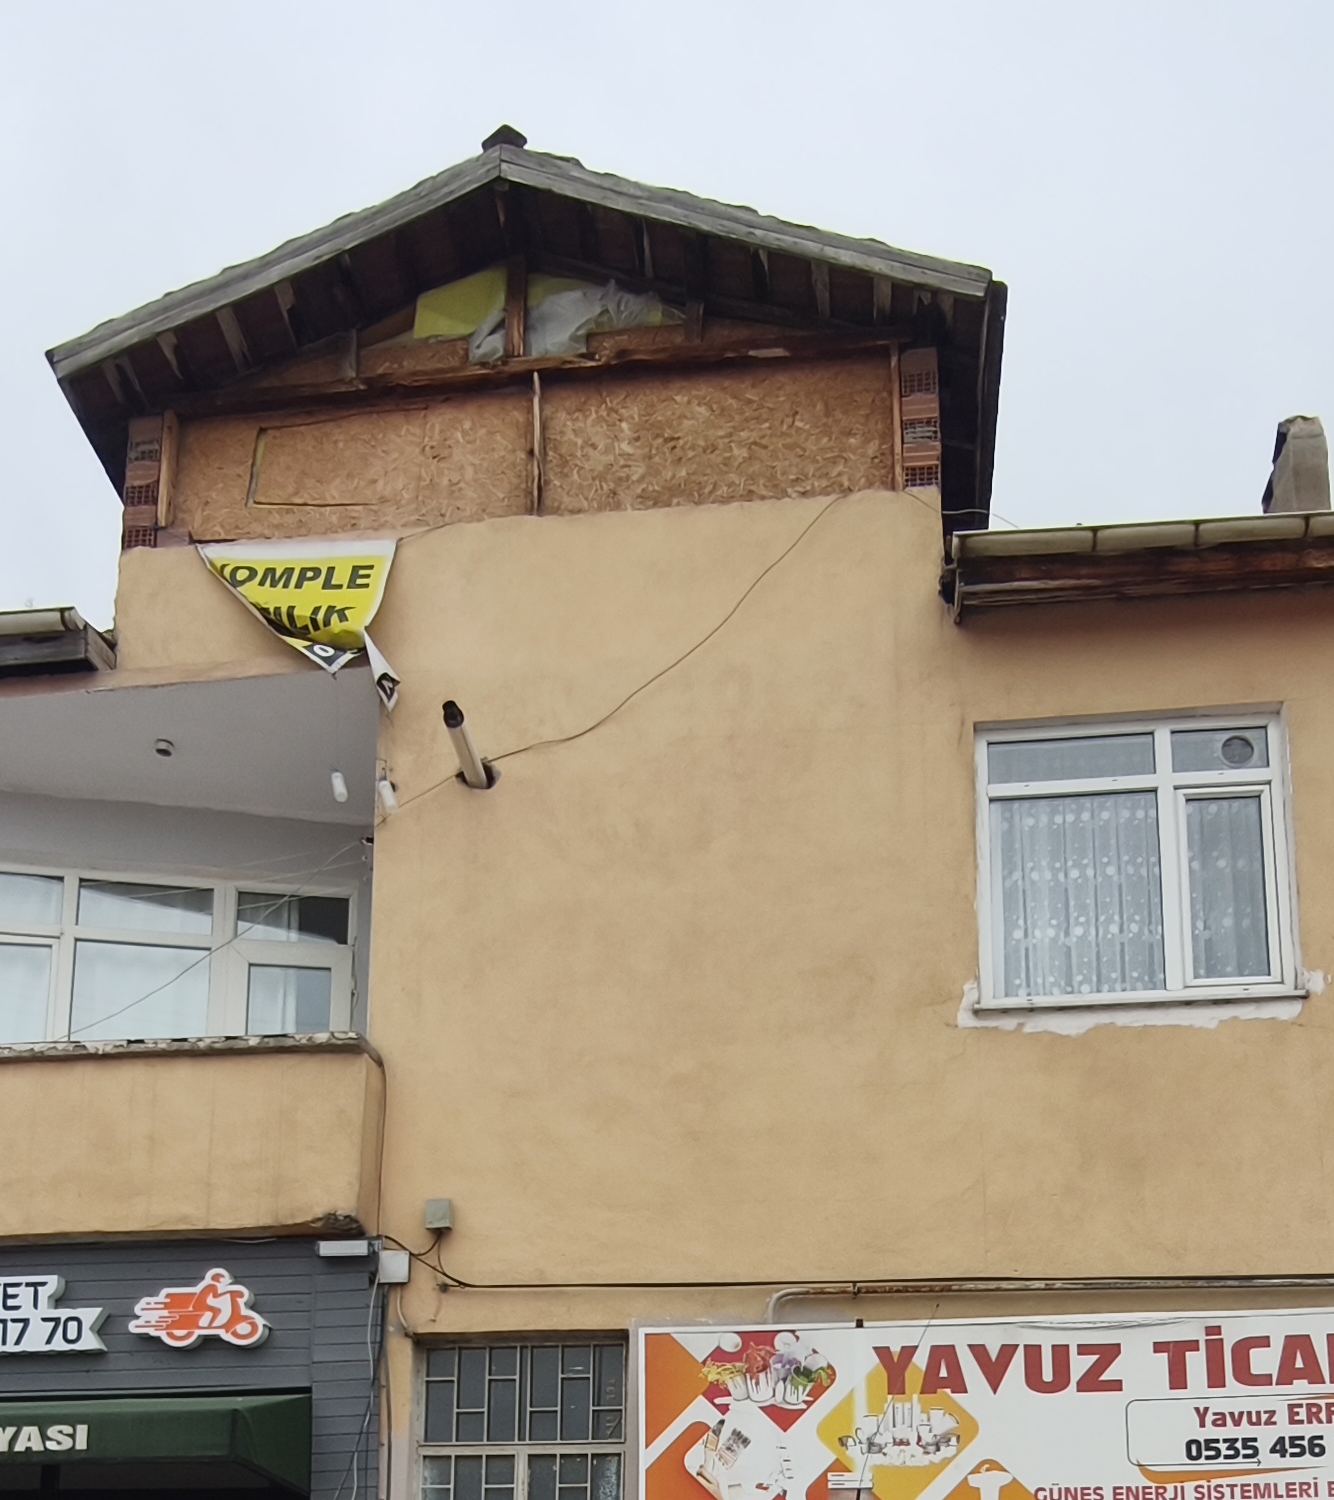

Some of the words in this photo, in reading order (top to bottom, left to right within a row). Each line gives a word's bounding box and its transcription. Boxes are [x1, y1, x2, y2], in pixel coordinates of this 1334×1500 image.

[219, 563, 375, 590] OMPLE
[41, 1316, 84, 1345] 70
[872, 1343, 1124, 1396] YAVUZ
[1194, 1406, 1278, 1429] Yavuz
[1185, 1437, 1260, 1461] 0535
[1269, 1435, 1326, 1459] 456
[1193, 1477, 1320, 1500] SİSTEMLERİ
